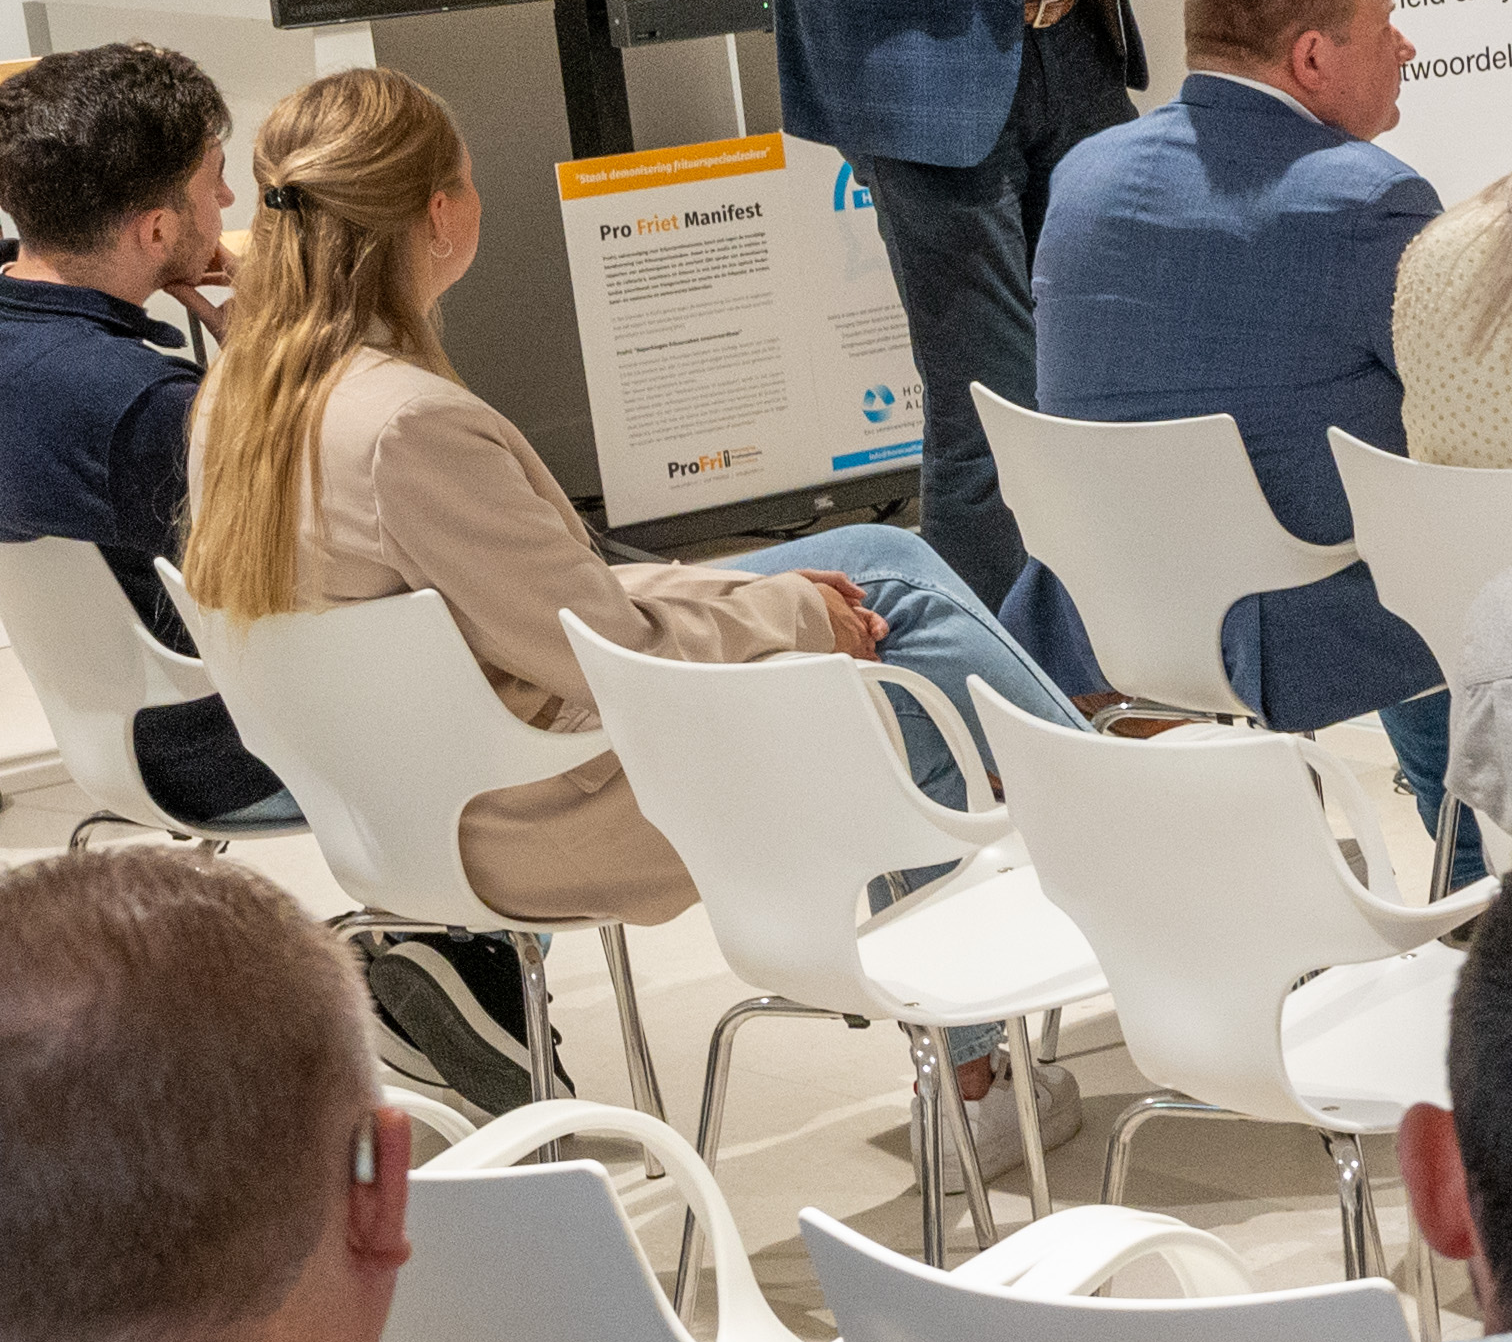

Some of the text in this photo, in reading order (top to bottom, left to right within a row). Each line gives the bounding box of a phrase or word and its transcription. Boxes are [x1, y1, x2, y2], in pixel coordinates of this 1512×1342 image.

[600, 202, 763, 241] Pro Friet Manifest
